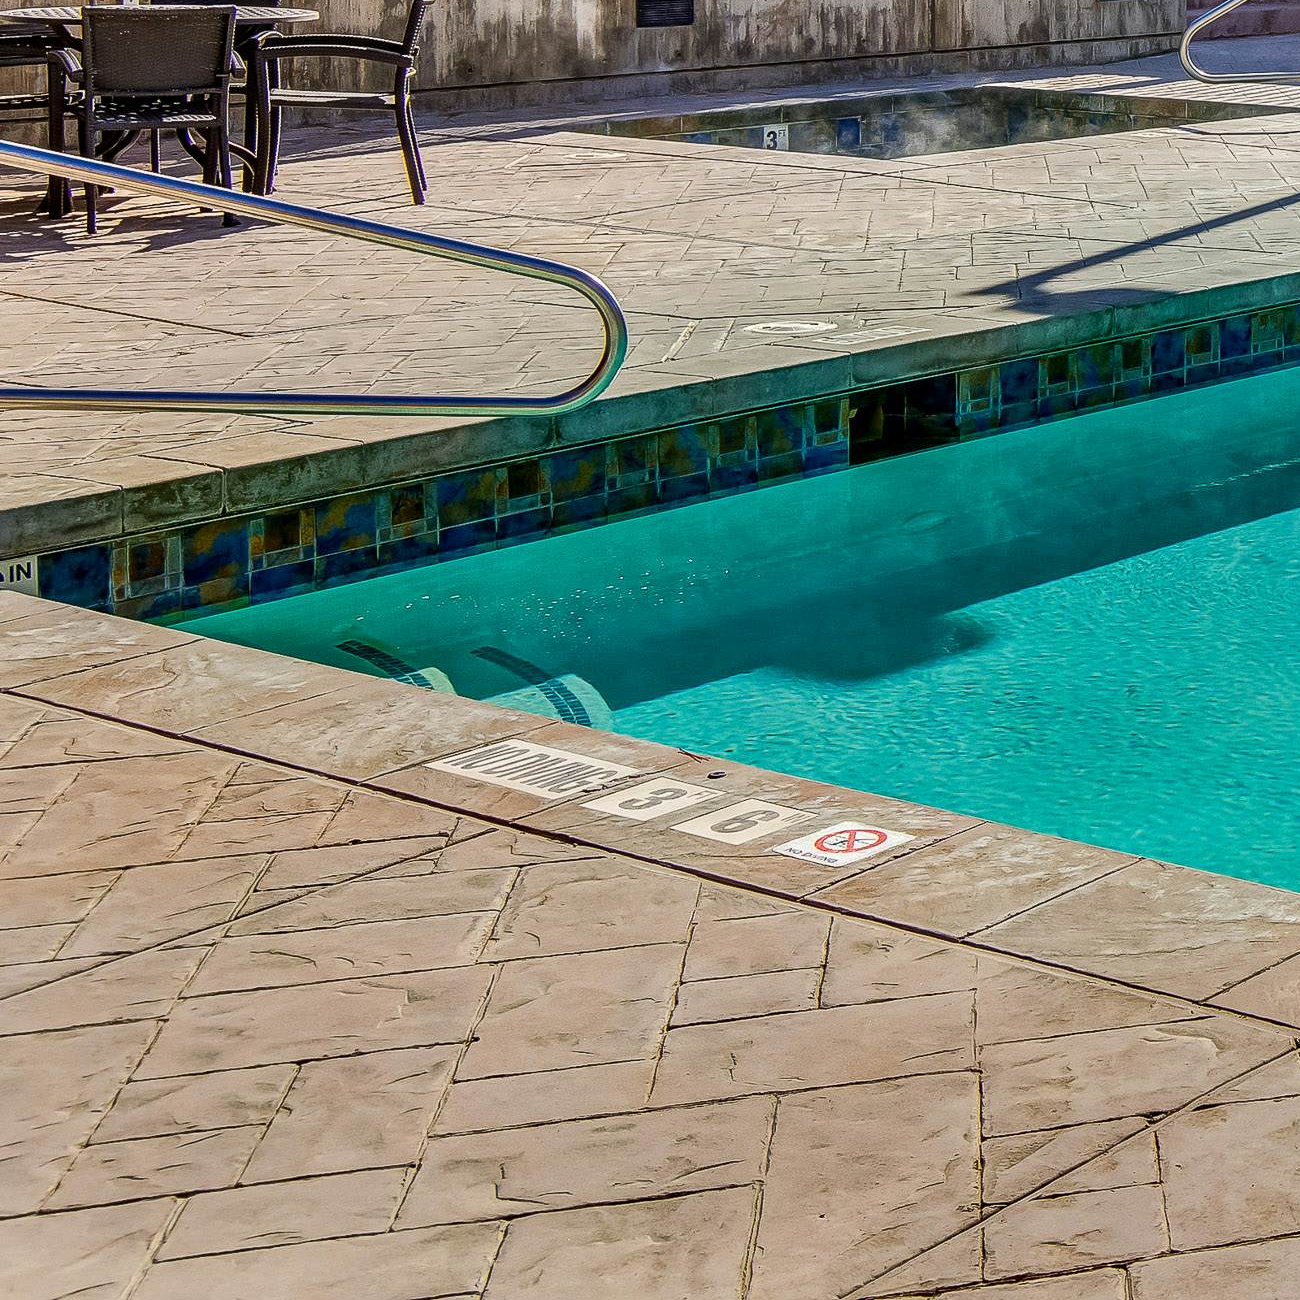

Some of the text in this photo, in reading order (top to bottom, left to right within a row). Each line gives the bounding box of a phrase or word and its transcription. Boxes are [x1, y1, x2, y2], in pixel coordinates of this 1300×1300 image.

[767, 131, 777, 150] 3
[442, 744, 619, 793] NO DIVING
[618, 787, 688, 811] 3
[710, 809, 780, 834] 6
